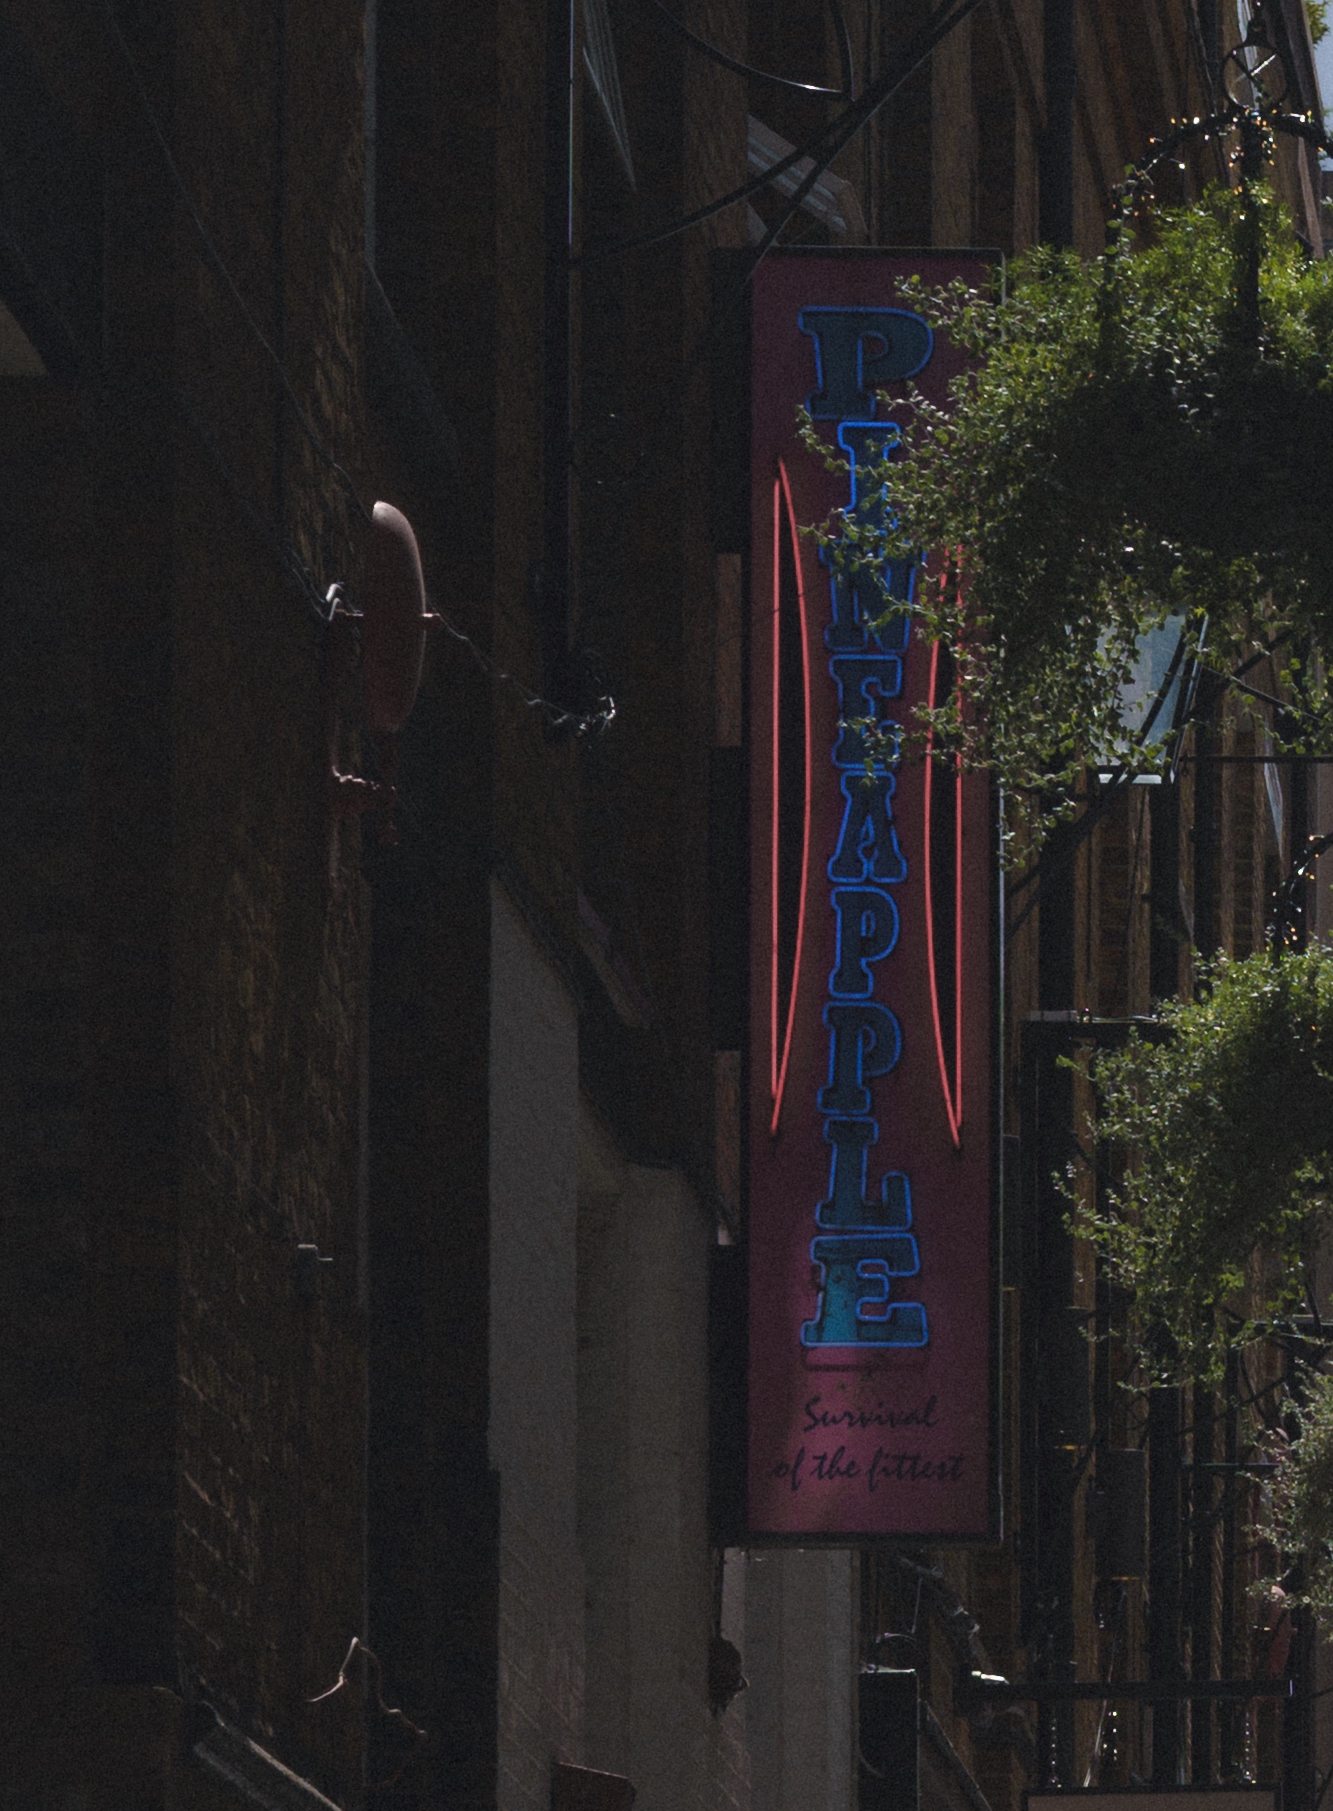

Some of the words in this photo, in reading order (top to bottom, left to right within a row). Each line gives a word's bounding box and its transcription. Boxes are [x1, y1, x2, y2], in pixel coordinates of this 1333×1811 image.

[798, 306, 934, 1347] PINEAPPLE
[803, 1394, 940, 1433] Survival
[773, 1446, 806, 1491] of
[811, 1445, 861, 1480] the
[867, 1446, 964, 1492] fittest
